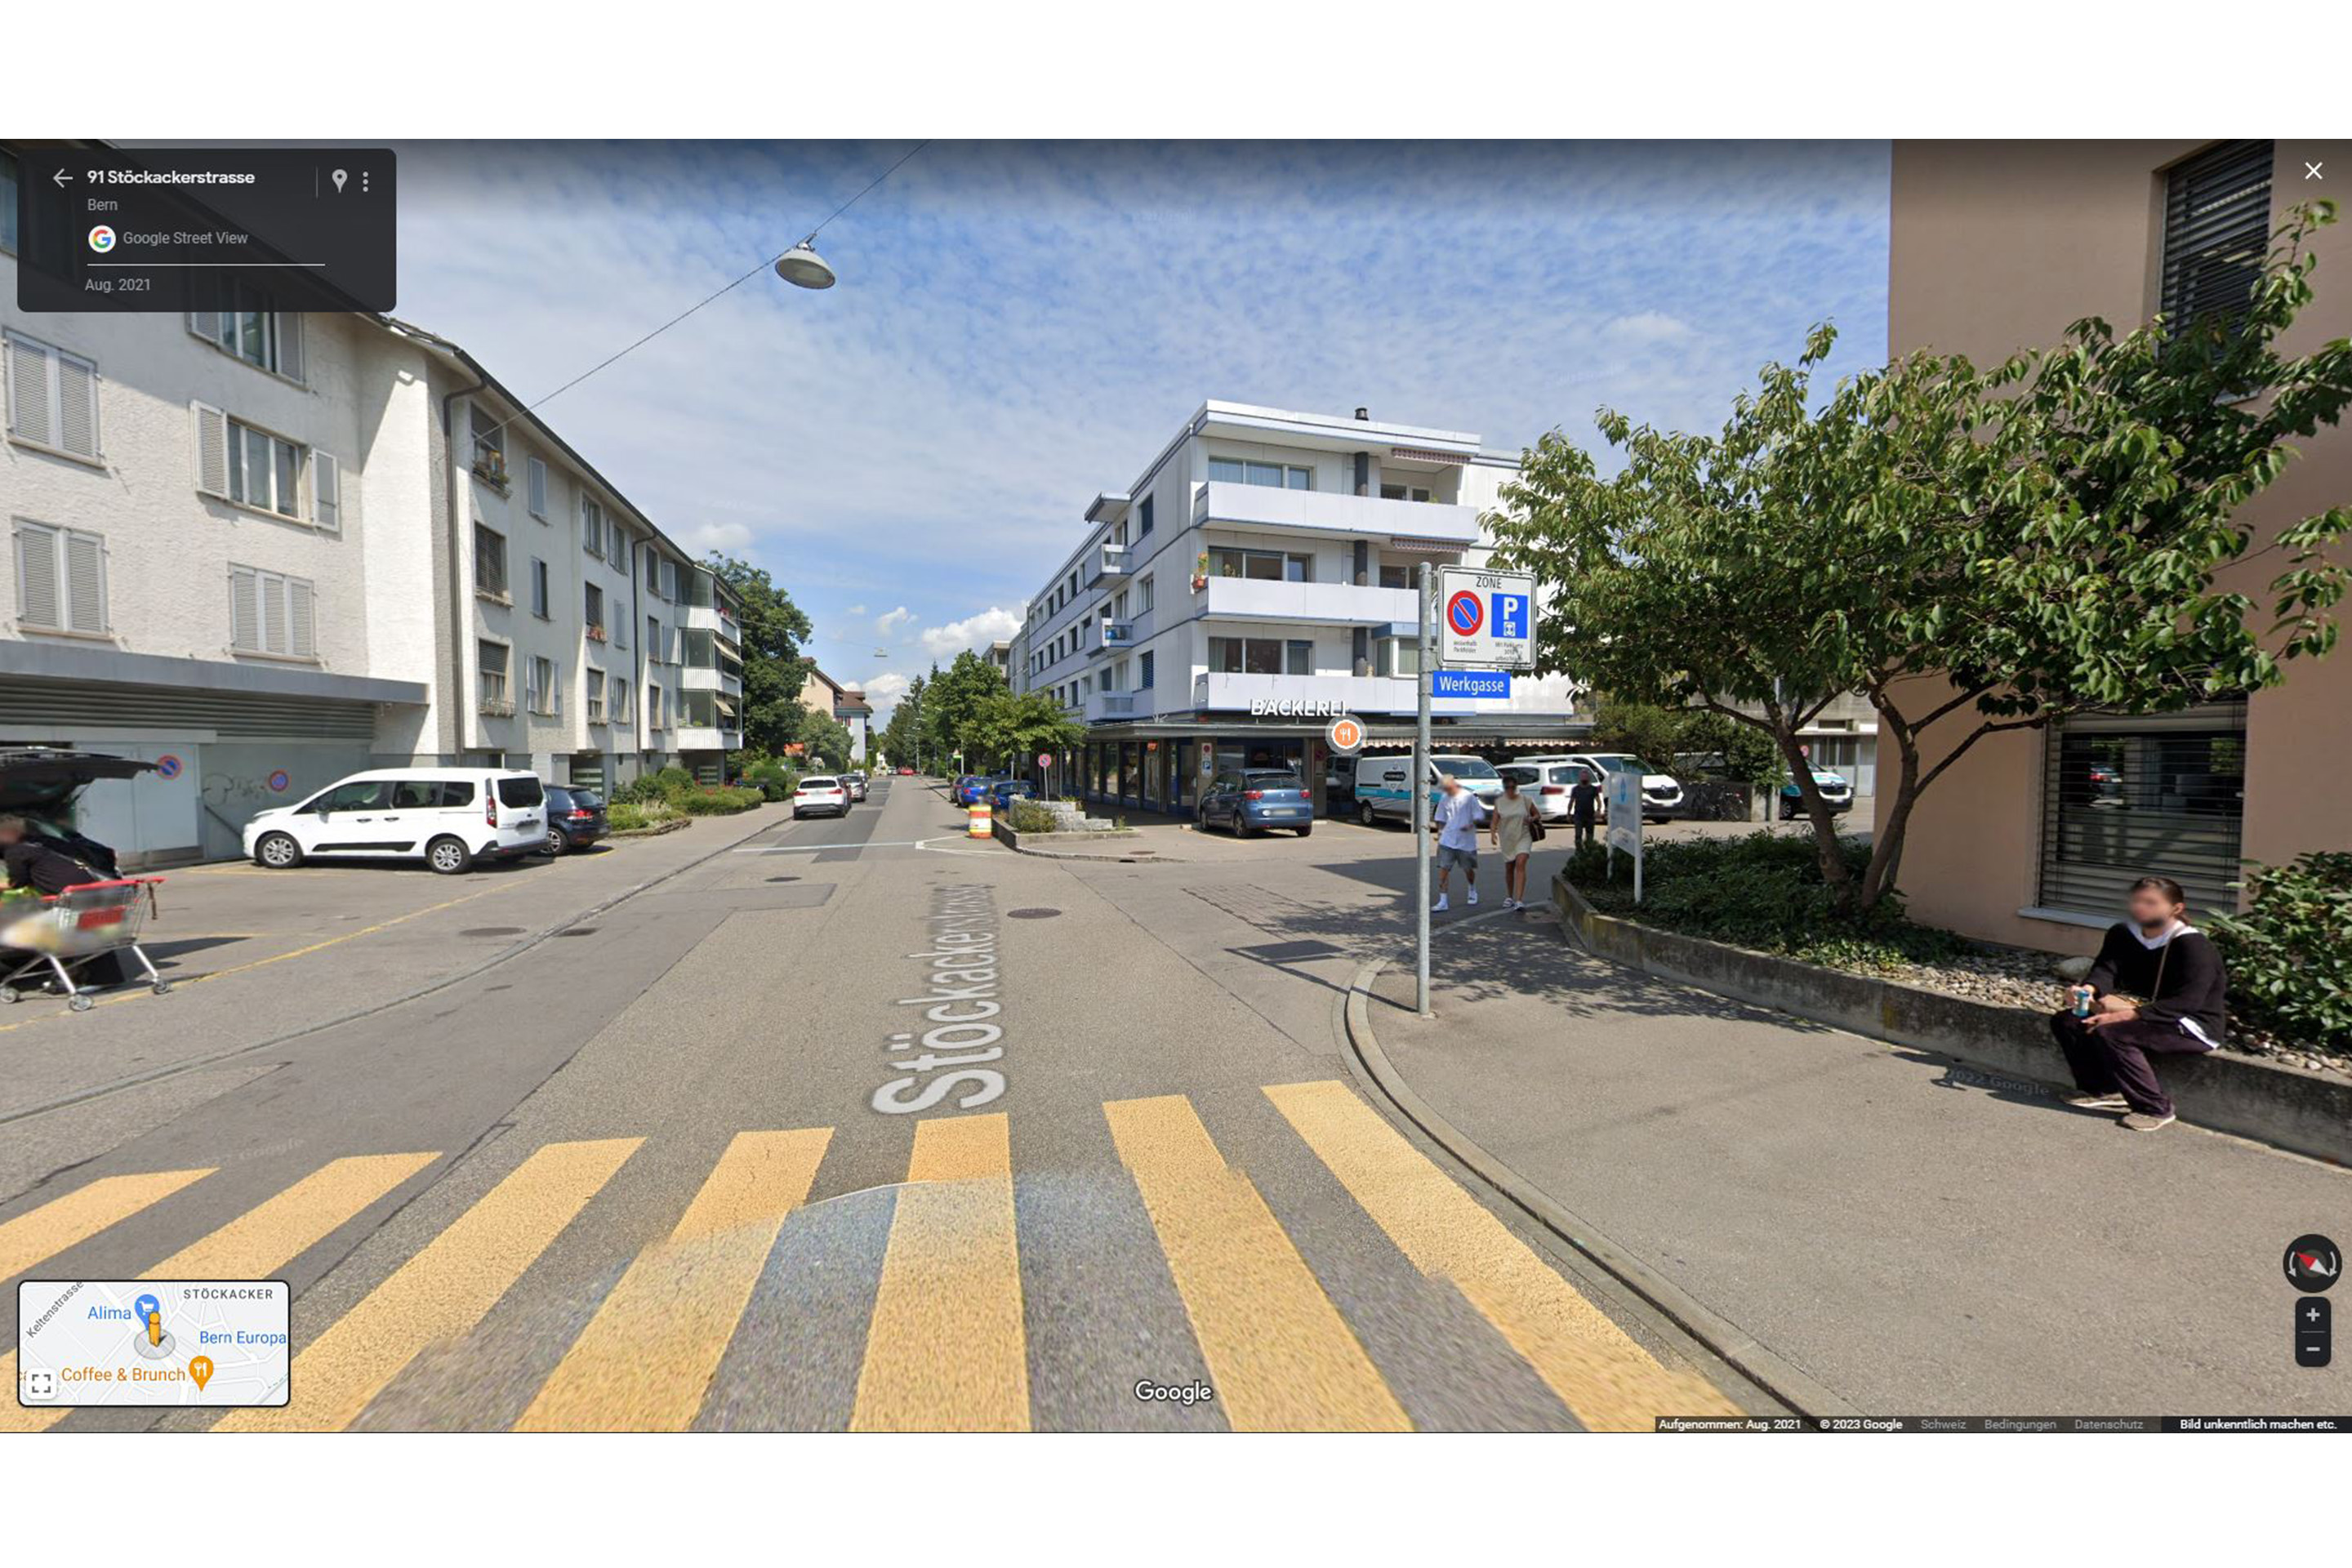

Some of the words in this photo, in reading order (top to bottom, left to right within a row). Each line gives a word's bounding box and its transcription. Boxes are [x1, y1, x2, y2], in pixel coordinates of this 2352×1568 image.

[1476, 577, 1503, 589] ZONE
[1503, 597, 1518, 621] P
[1439, 675, 1505, 696] Werkgasse
[1250, 698, 1347, 716] BÄCKEREI
